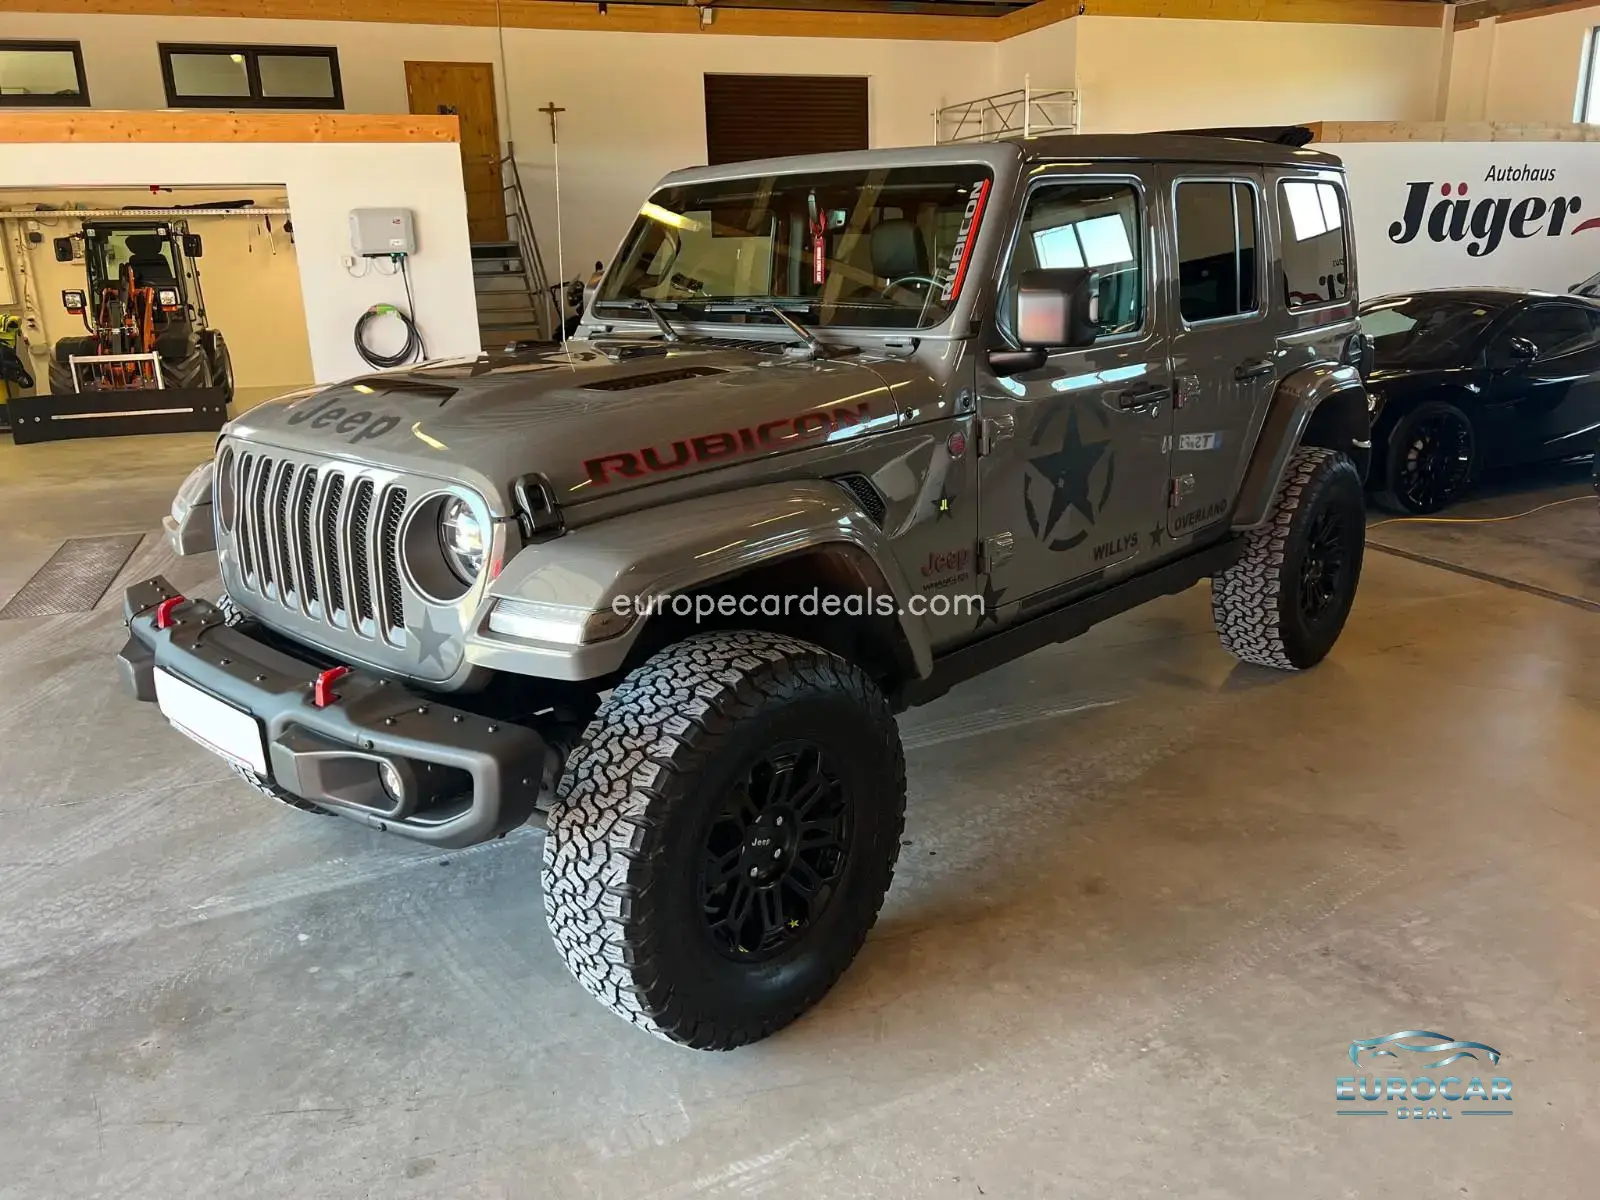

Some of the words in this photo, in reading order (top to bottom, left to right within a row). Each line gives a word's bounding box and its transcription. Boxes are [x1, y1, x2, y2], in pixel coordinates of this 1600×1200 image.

[1485, 164, 1556, 182] Autohaus
[1388, 181, 1582, 257] Jäger
[941, 180, 985, 301] RUBICON
[286, 398, 402, 444] Jeep
[582, 402, 871, 487] RUBICON
[1174, 498, 1228, 531] OVERLAND
[920, 548, 970, 577] Jeep
[1093, 531, 1139, 561] WILLYS
